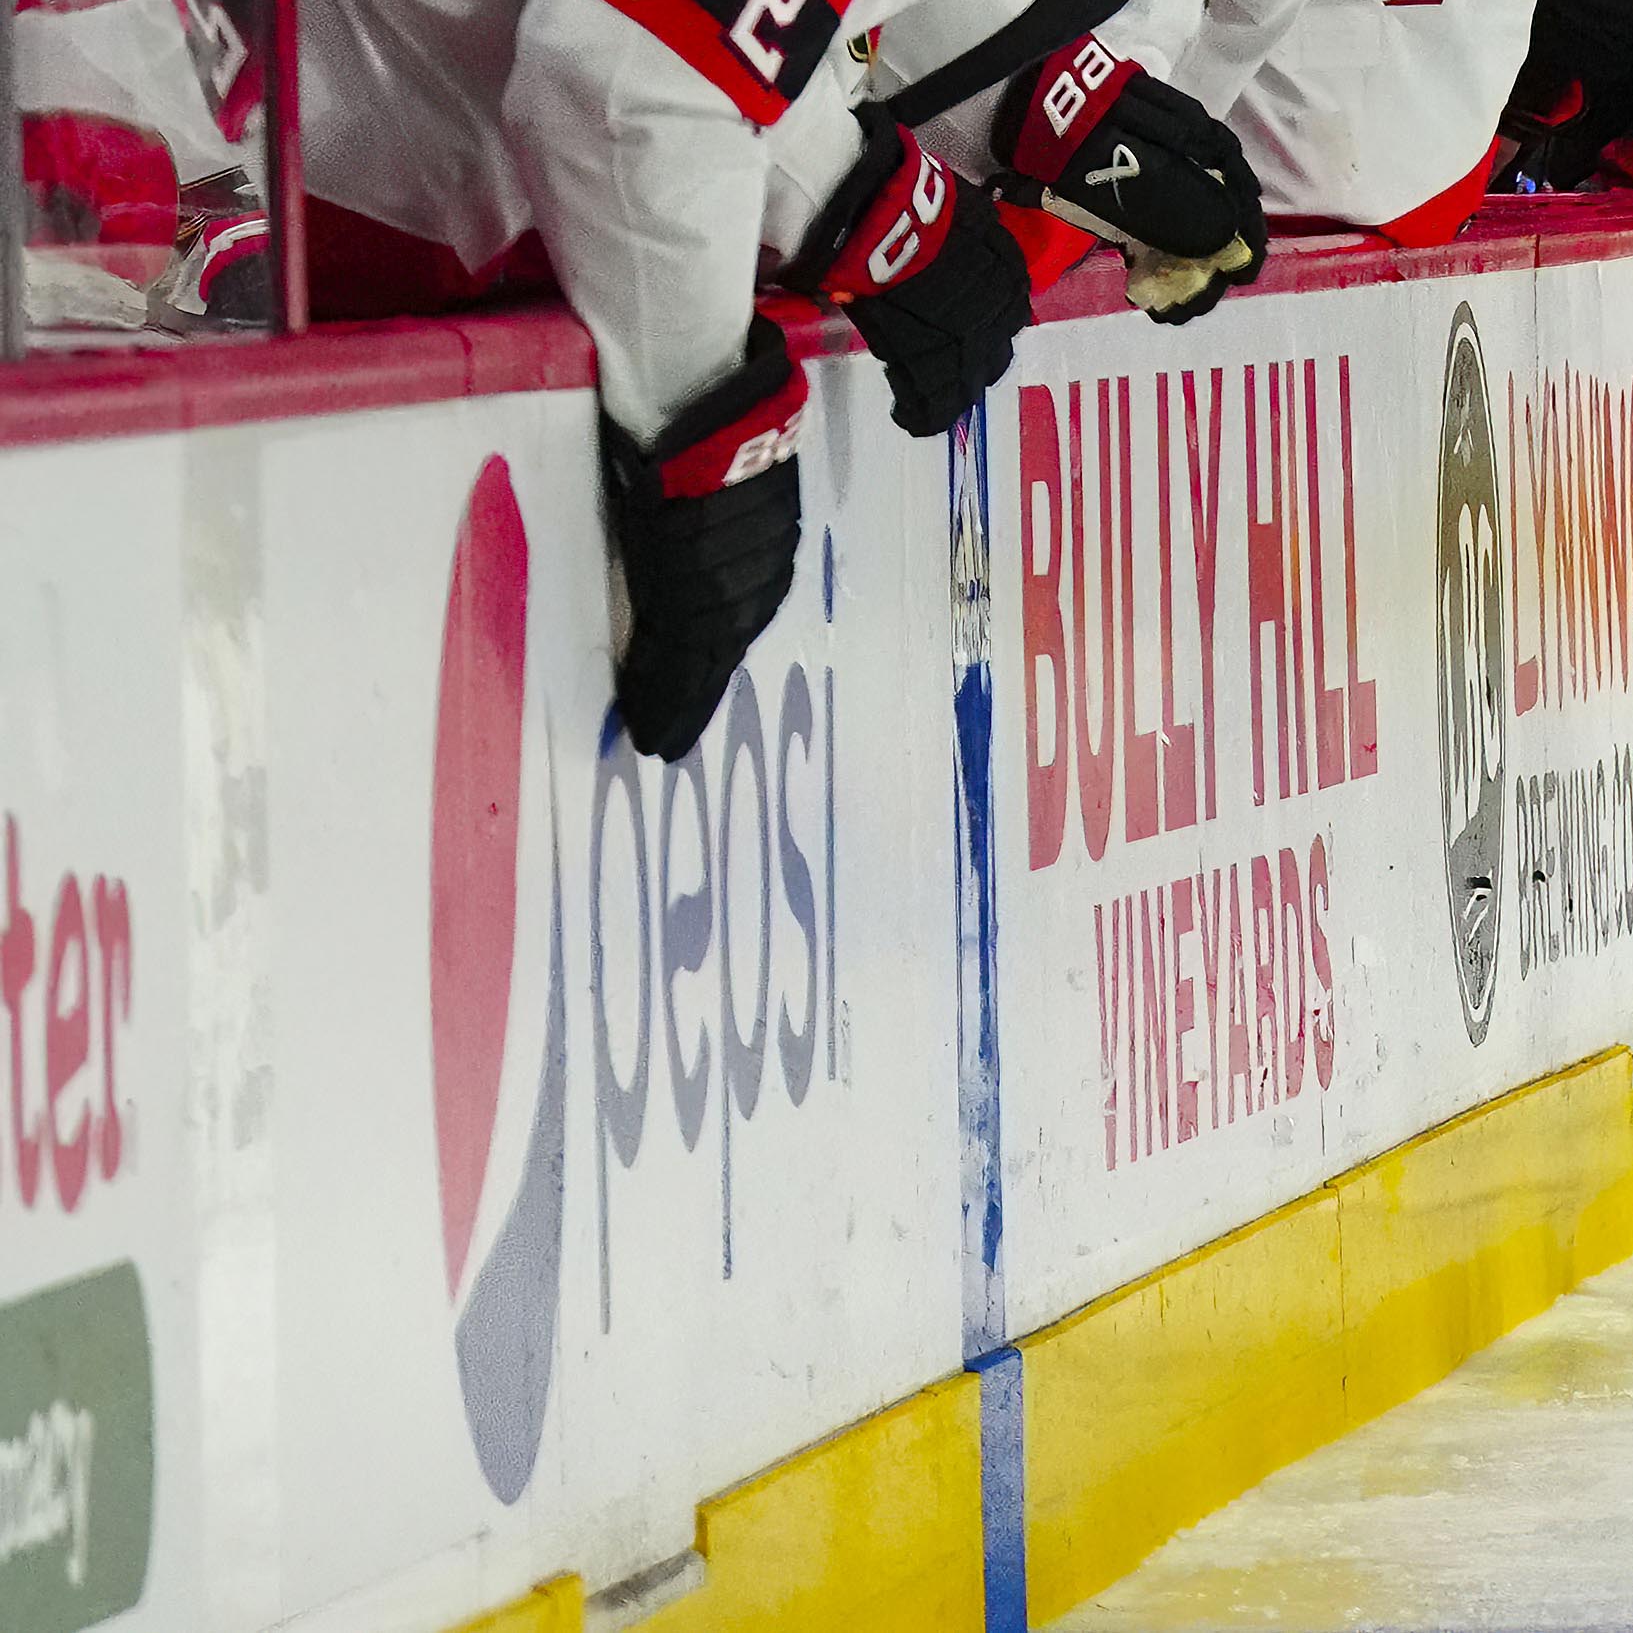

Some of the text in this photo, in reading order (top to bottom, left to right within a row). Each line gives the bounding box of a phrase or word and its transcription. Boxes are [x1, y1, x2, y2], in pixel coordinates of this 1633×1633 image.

[1016, 366, 1223, 872] BULLY
[1243, 353, 1379, 808] HILL
[590, 523, 841, 1335] pepsi
[1093, 832, 1335, 1172] VINEYARDS
